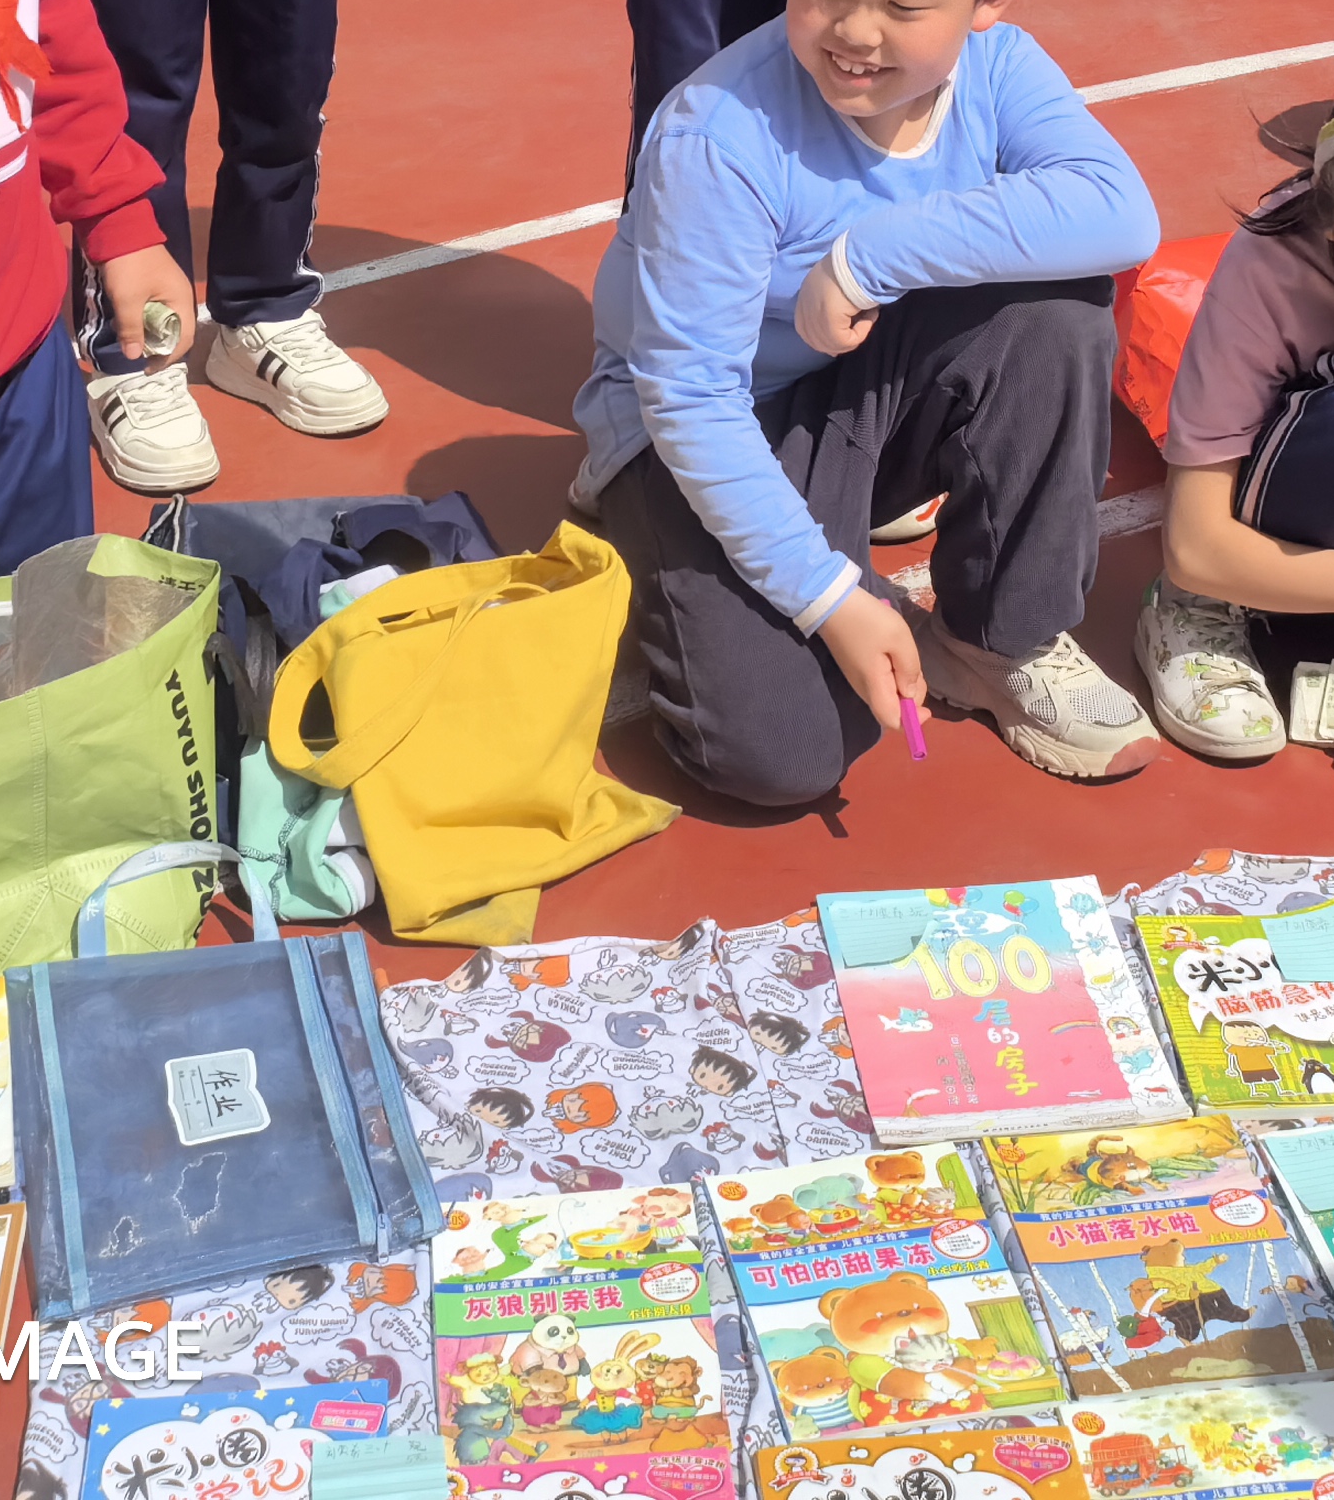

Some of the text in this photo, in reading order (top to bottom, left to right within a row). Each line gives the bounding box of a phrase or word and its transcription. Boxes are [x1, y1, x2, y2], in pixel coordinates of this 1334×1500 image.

[165, 669, 200, 767] YUYU
[186, 769, 216, 843] SHO
[891, 933, 1054, 1000] 100
[1187, 954, 1283, 993] 米小
[973, 999, 1039, 1097] 层的房子
[1048, 1211, 1203, 1249] 小猫落水啦
[748, 1243, 937, 1289] 可怕的甜果冻
[464, 1284, 625, 1321] 灰狼别亲我
